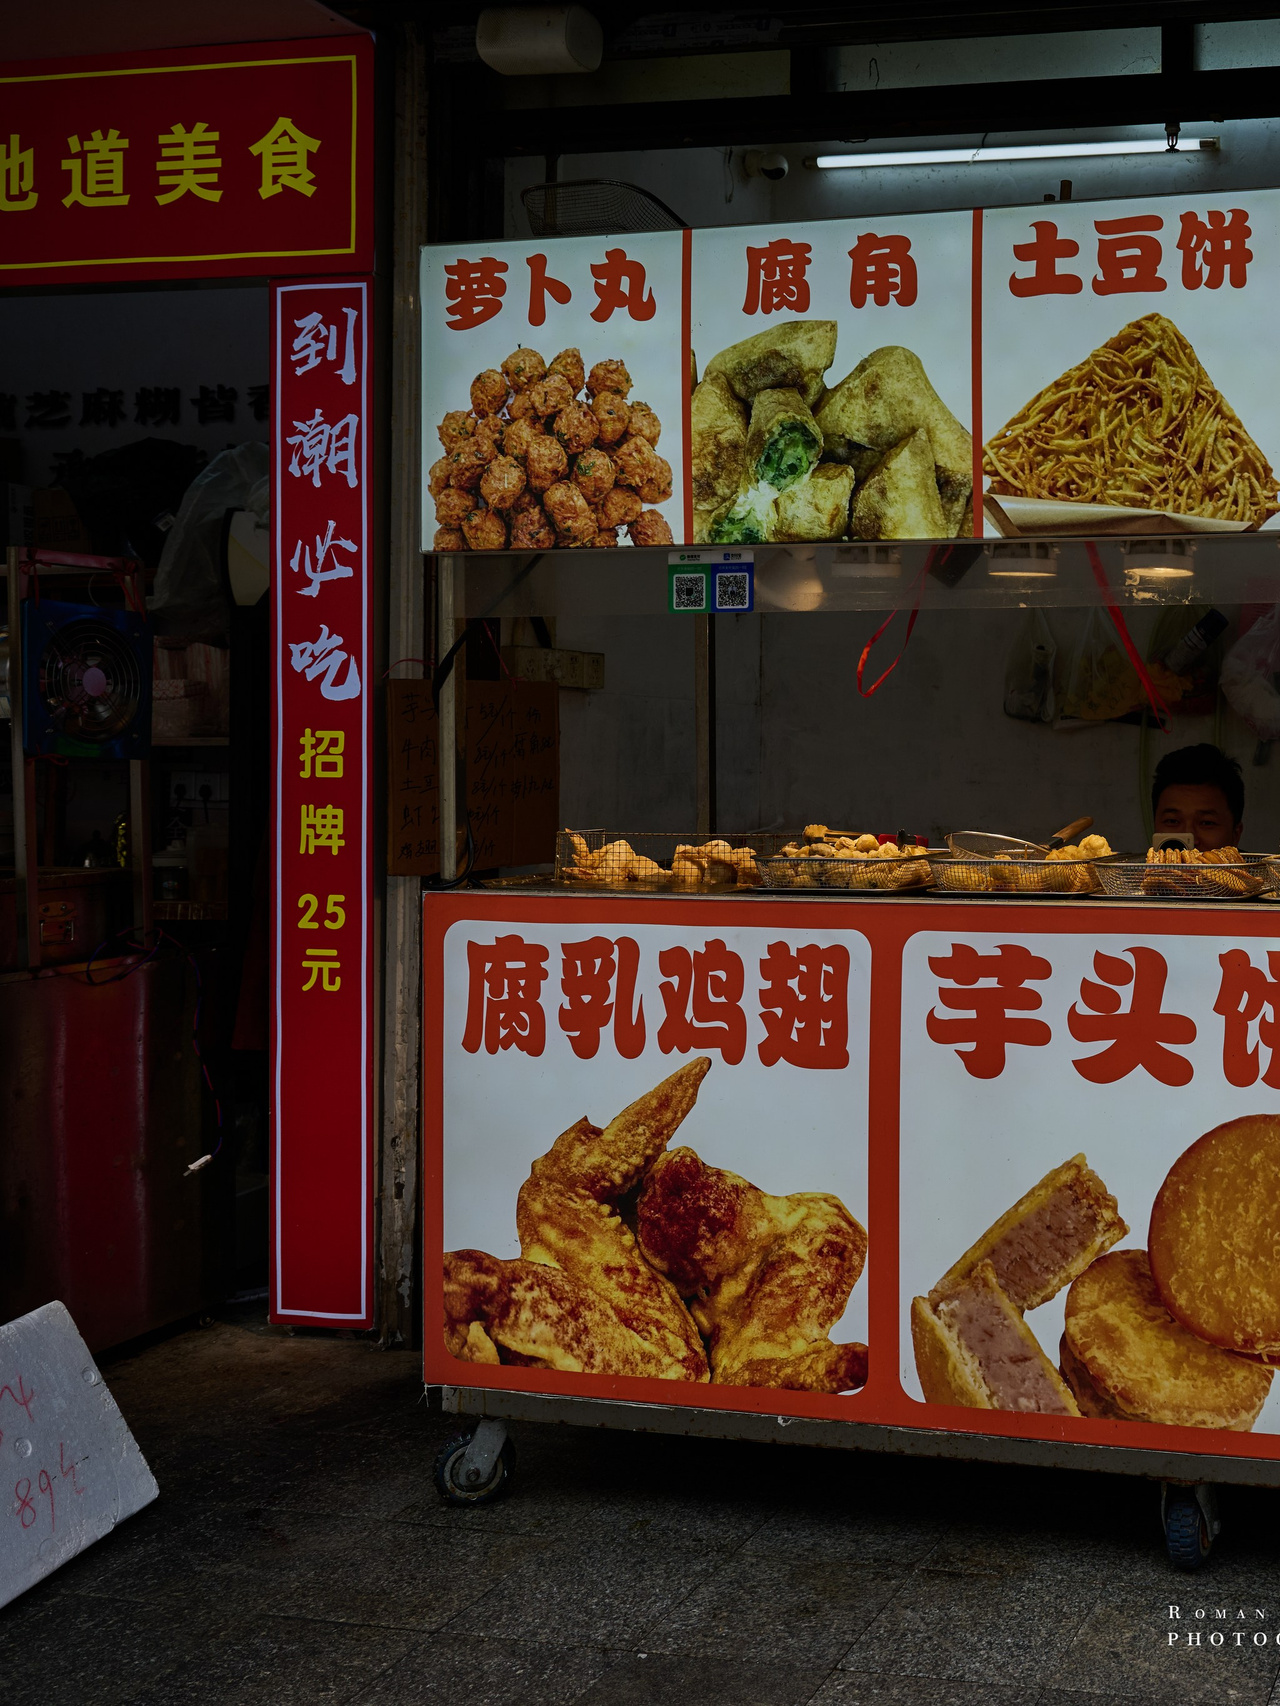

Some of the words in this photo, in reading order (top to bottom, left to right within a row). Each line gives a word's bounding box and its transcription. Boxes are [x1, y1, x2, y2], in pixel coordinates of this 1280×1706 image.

[445, 248, 656, 331] 萝卜丸
[743, 233, 918, 315] 腐角
[1009, 208, 1253, 298] 土豆饼
[287, 307, 362, 701] 到潮必吃
[298, 728, 346, 992] 招牌25元
[462, 934, 852, 1070] 腐乳鸡翅
